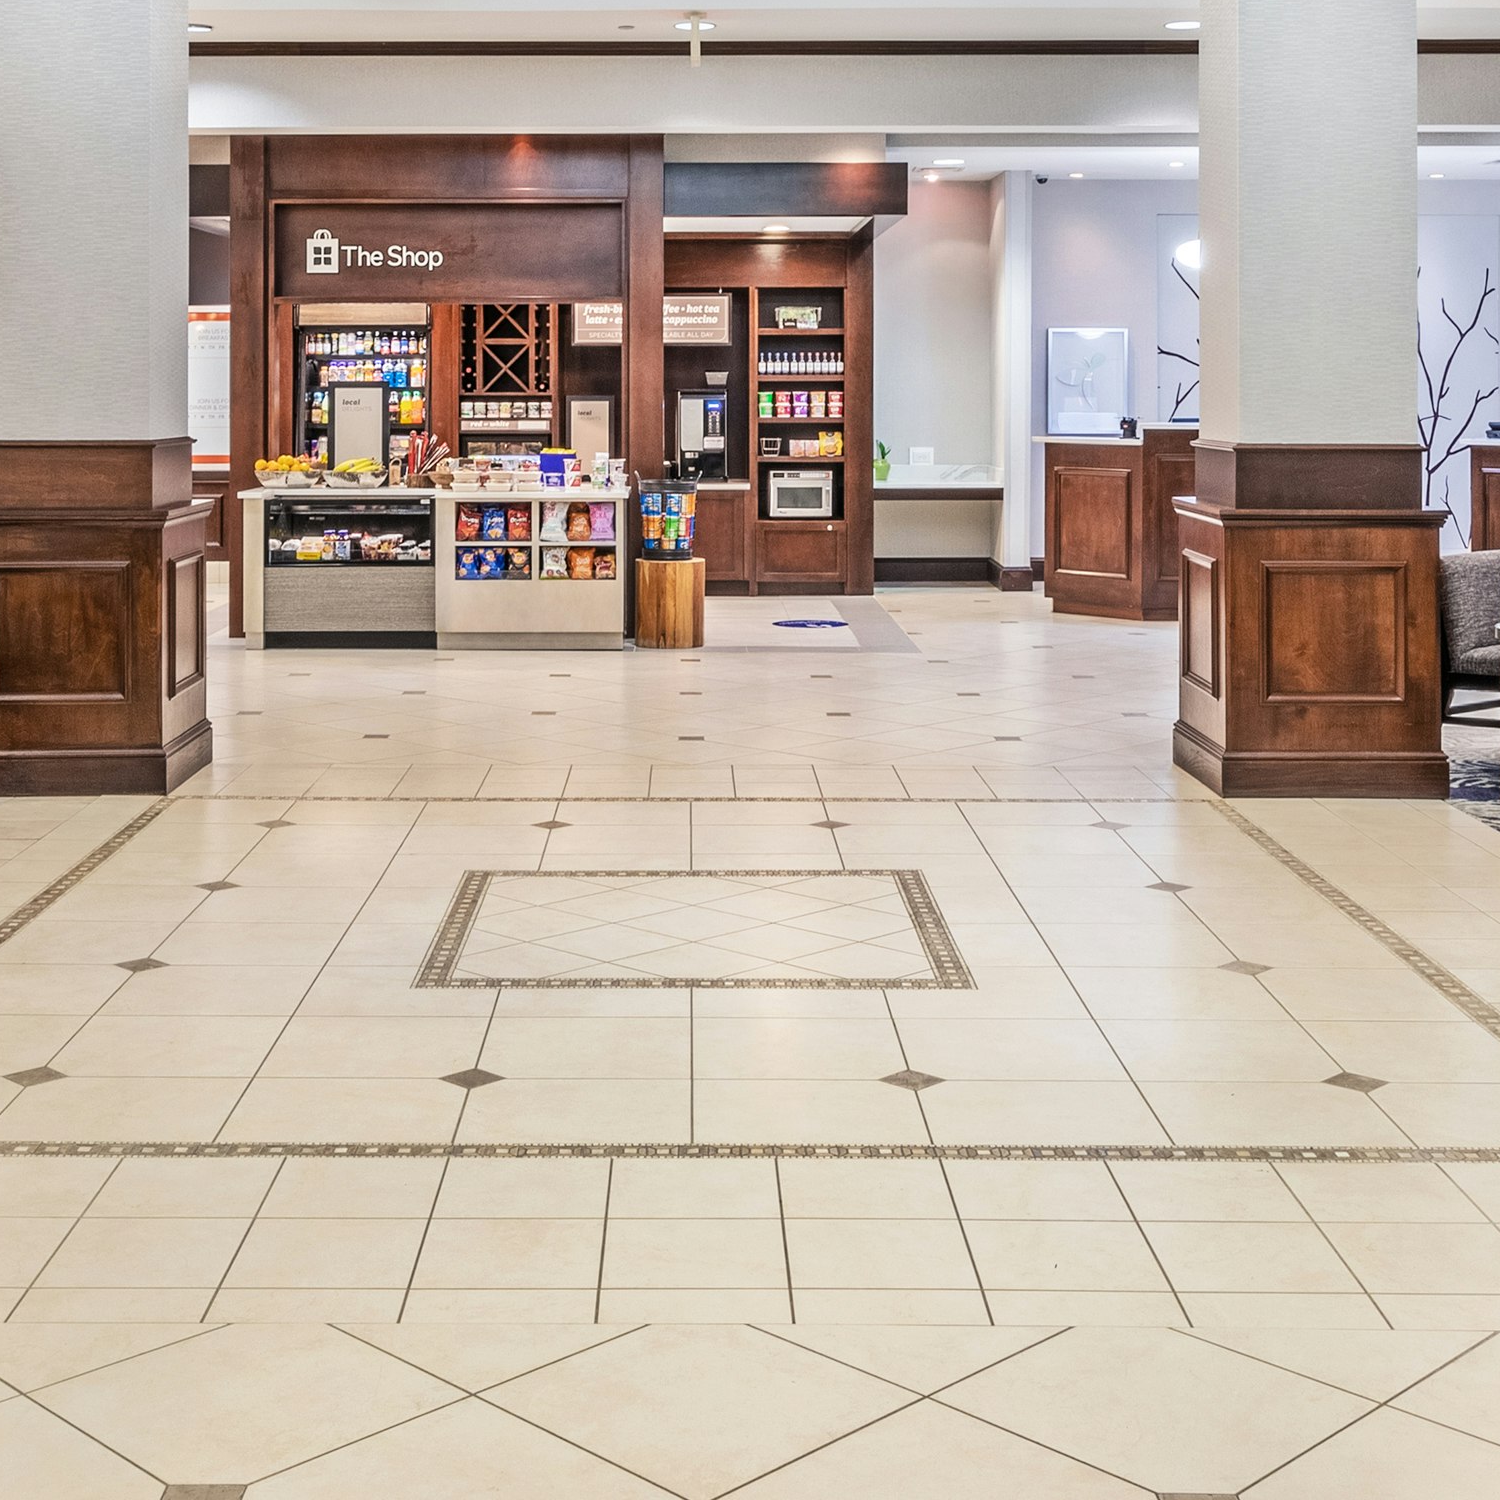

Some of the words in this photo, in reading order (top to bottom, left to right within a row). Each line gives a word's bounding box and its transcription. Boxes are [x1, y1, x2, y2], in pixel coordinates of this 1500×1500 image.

[341, 245, 384, 267] The
[387, 245, 444, 271] Shop
[686, 304, 703, 314] hot
[703, 305, 720, 314] tea
[585, 315, 608, 325] latte
[342, 398, 361, 406] local
